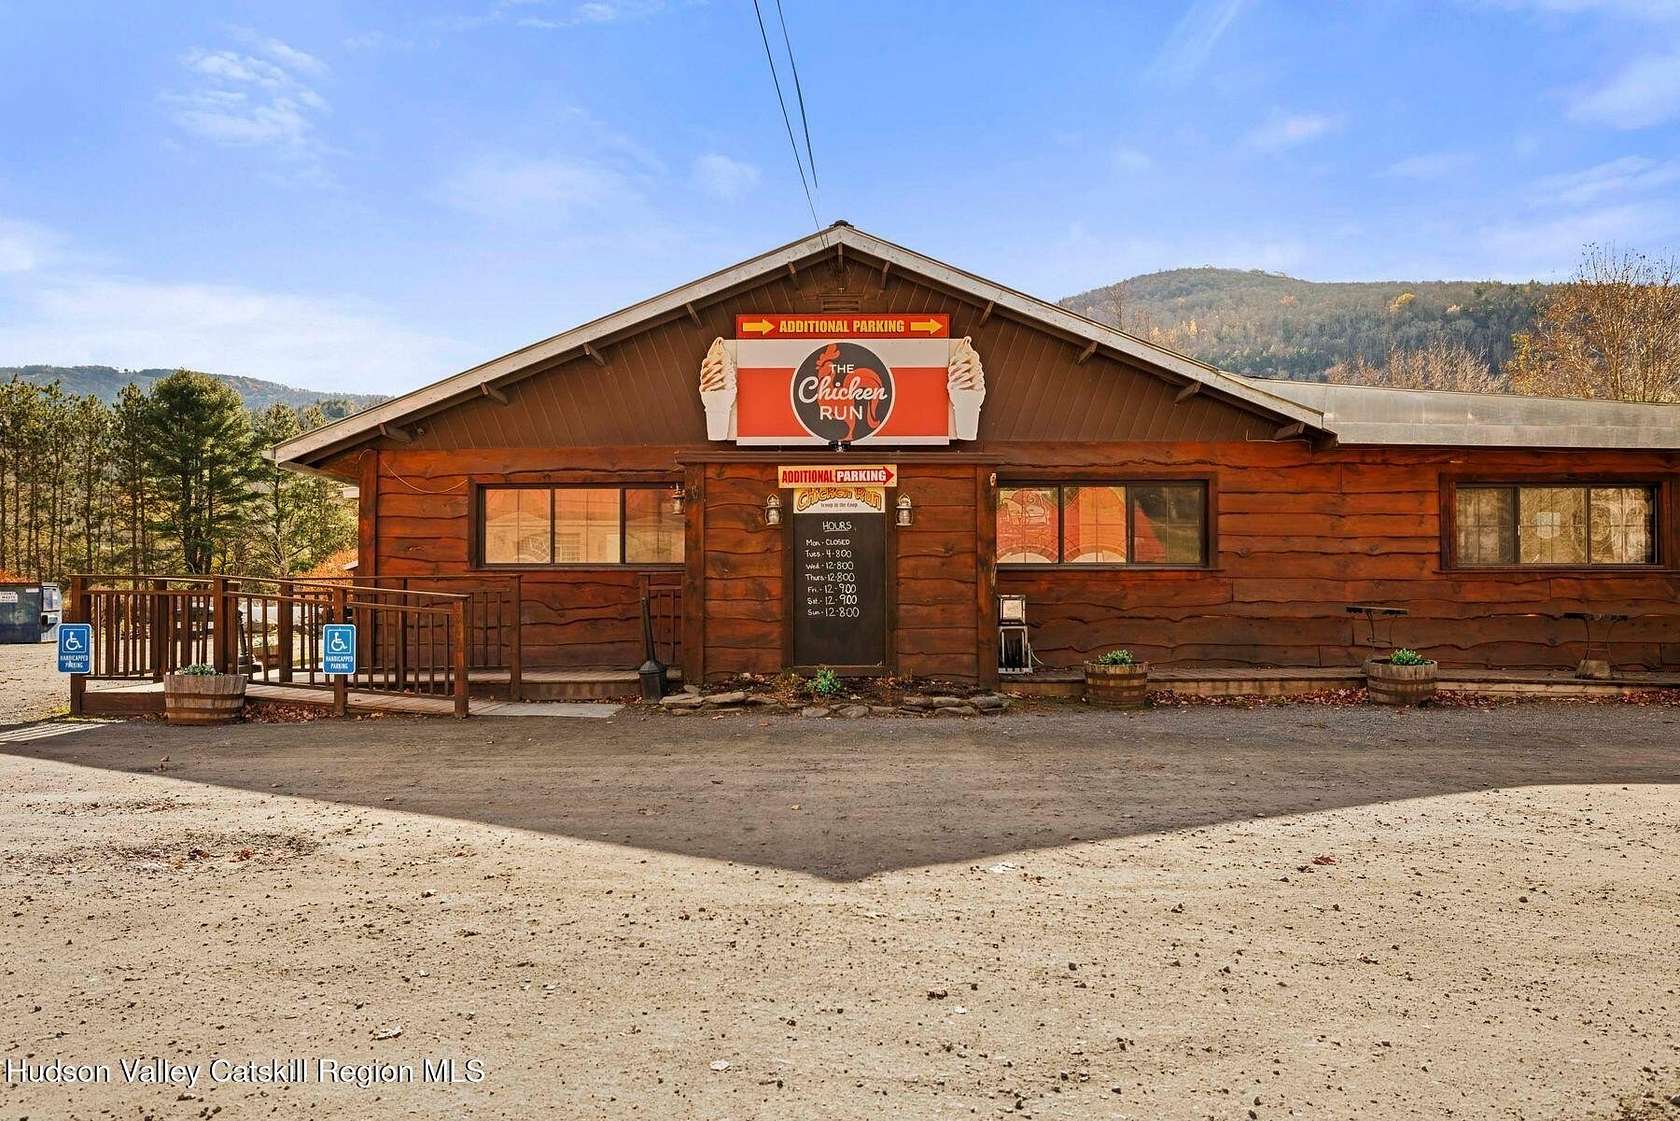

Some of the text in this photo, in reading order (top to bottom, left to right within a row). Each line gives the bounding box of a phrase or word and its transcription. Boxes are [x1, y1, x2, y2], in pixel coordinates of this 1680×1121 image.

[779, 320, 905, 333] ADDITIONAL PARKING
[830, 364, 855, 374] THE
[798, 376, 888, 404] Chicken
[819, 405, 863, 420] RUN
[782, 470, 887, 484] ADDITIONAL PARKING
[822, 520, 852, 531] HOURS
[60, 654, 89, 662] HANDICAPPED
[325, 655, 354, 663] HANDICAPPED
